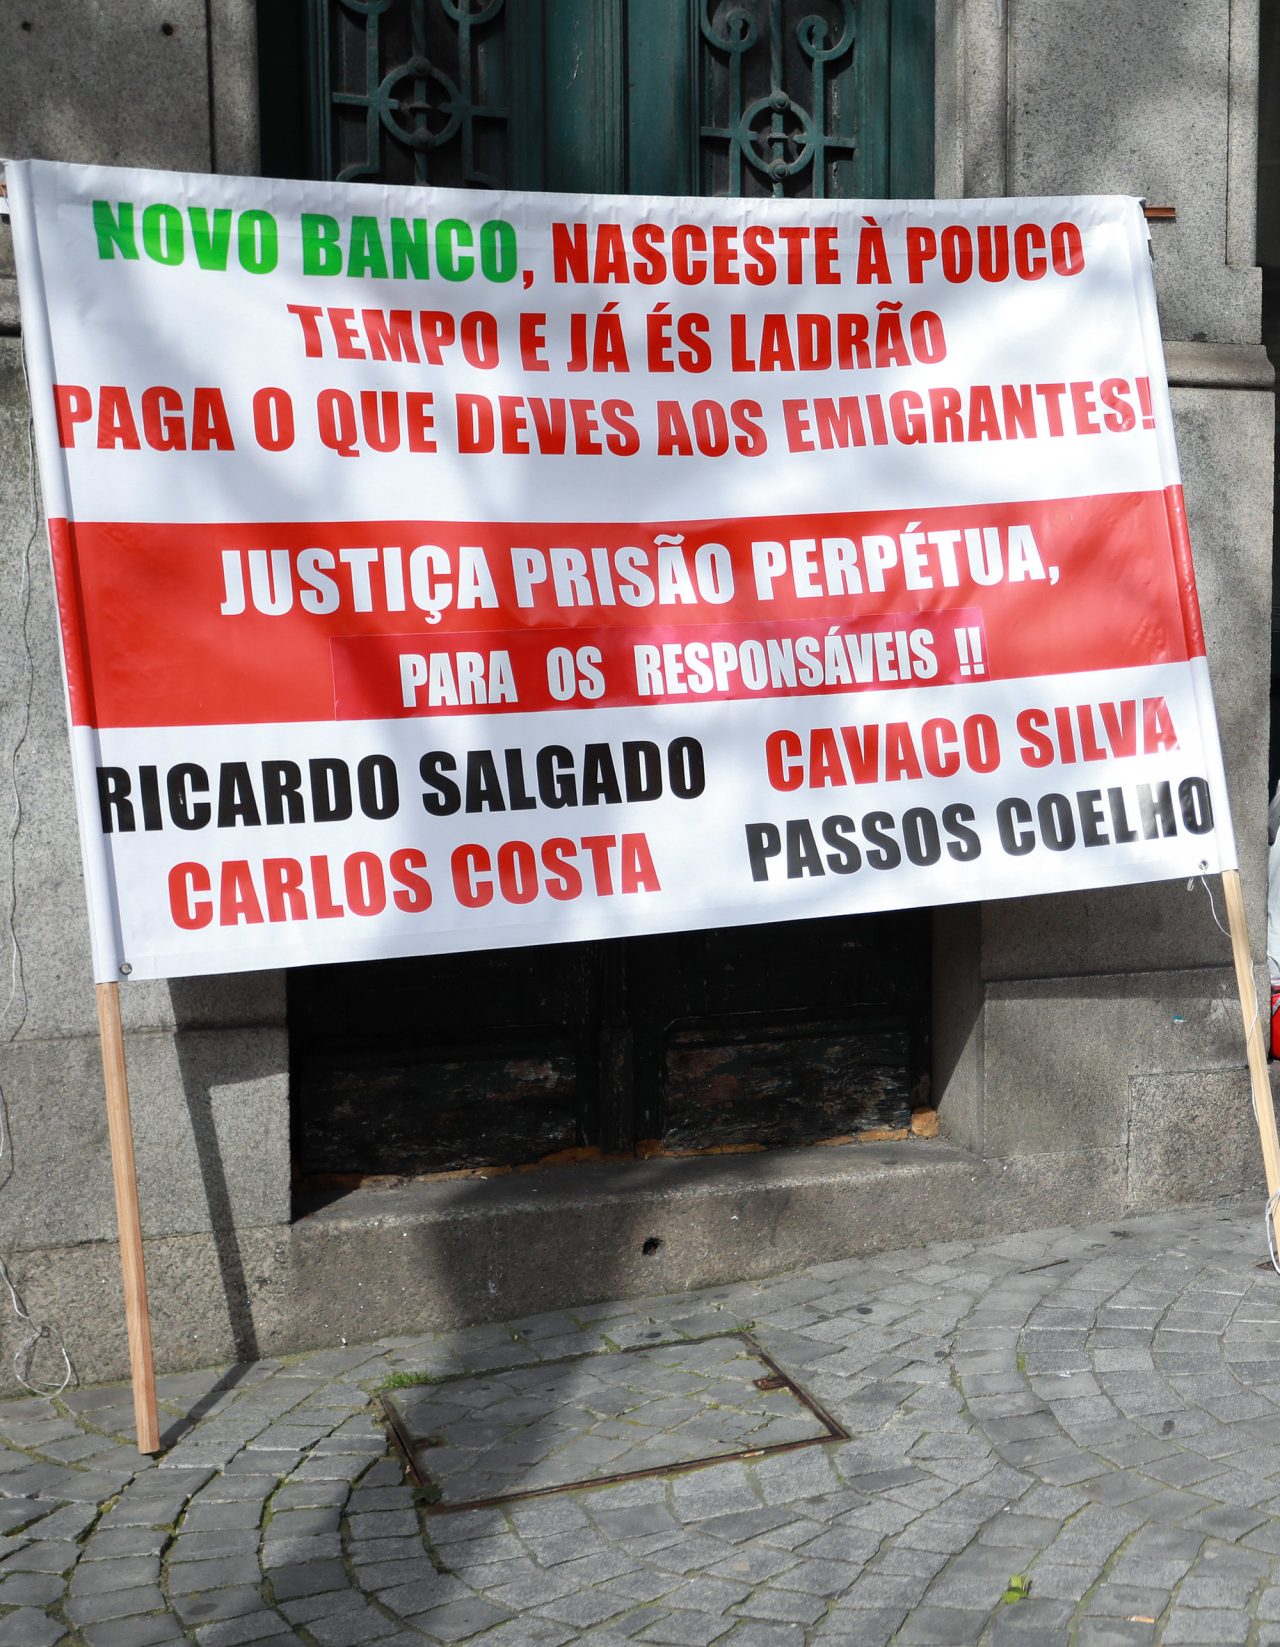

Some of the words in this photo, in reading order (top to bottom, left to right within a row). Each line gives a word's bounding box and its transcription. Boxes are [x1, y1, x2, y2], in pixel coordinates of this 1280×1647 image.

[95, 202, 278, 274] NOVO
[303, 215, 533, 288] BANCO,
[553, 223, 840, 285] NASCESTE
[857, 216, 891, 284] À
[907, 222, 1084, 283] POUCO
[288, 304, 498, 369] TEMPO
[520, 313, 548, 371] E
[568, 302, 629, 372] JÁ
[647, 302, 711, 373] ÉS
[731, 301, 946, 372] LADRÃO
[54, 385, 234, 451] PAGA
[253, 387, 294, 451] O
[318, 389, 437, 457] QUE
[456, 394, 639, 456] DEVES
[658, 400, 767, 457] AOS
[784, 376, 1156, 452] EMIGRANTES!
[221, 545, 498, 624] JUSTIÇA
[511, 534, 734, 607] PRISÃO
[751, 522, 1059, 600] PERPÉTUA,
[400, 651, 518, 707] PARA
[547, 646, 605, 700] OS
[634, 626, 938, 696] RESPONSÁVEIS
[96, 755, 399, 833] RICARDO
[420, 737, 705, 816] SALGADO
[766, 715, 1000, 791] CAVACO
[1017, 697, 1180, 768] SILVA
[746, 804, 980, 881] PASSOS
[998, 778, 1214, 851] COELHO
[169, 848, 432, 930] CARLOS
[452, 833, 659, 907] COSTA
